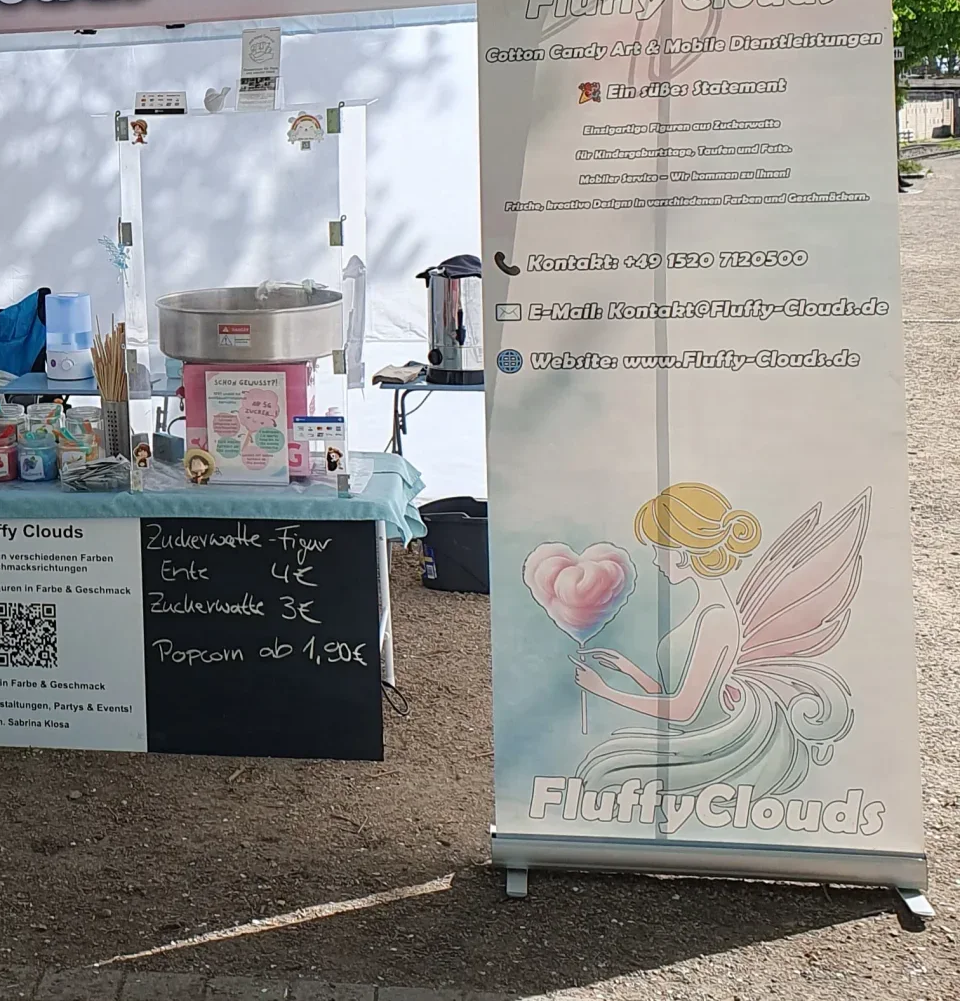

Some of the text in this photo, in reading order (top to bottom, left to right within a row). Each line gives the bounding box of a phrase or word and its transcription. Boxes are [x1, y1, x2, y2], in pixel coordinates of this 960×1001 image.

[485, 31, 882, 63] Cotton Candy Art & Mobile Dienstleistungen
[606, 78, 787, 99] Ein süßes Statement
[583, 119, 781, 136] Einzigartige Figuren aus Zuckerwatte
[575, 143, 792, 160] für Kindergeburtstage, Taufen und Feste.
[579, 174, 619, 184] Mobiler
[621, 172, 658, 183] Service
[669, 171, 690, 181] Wir
[692, 170, 738, 180] kommen
[740, 171, 753, 179] zu
[755, 168, 791, 179] Ihnen!
[504, 192, 870, 213] Frische, kreative Designs in verschiedenen Farben und Geschmäckern.
[527, 250, 808, 273] Kontakt: +49 1520 7120500
[528, 298, 889, 321] E-Mail: Kontakt@Fluffy-Clouds.de
[530, 349, 860, 371] Website: www.Fluffy-Clouds.de
[23, 524, 84, 539] Clouds
[146, 522, 262, 549] Zuckerwatte
[9, 553, 78, 561] verschiedenen
[81, 554, 114, 562] Farben
[161, 560, 318, 586] Ente 4€
[36, 585, 63, 593] Farbe
[75, 586, 131, 595] Geschmack
[148, 592, 322, 623] Zuckerwatte 3€
[152, 639, 243, 666] Popcorn
[259, 636, 293, 659] ab
[0, 679, 8, 687] in
[11, 680, 37, 688] Farbe
[40, 680, 46, 688] &
[50, 681, 106, 690] Geschmack
[54, 702, 84, 712] Partys
[97, 704, 133, 713] Events!
[8, 719, 42, 727] Sabrina
[44, 720, 70, 728] Klosa
[529, 775, 886, 836] FluffyClouds
